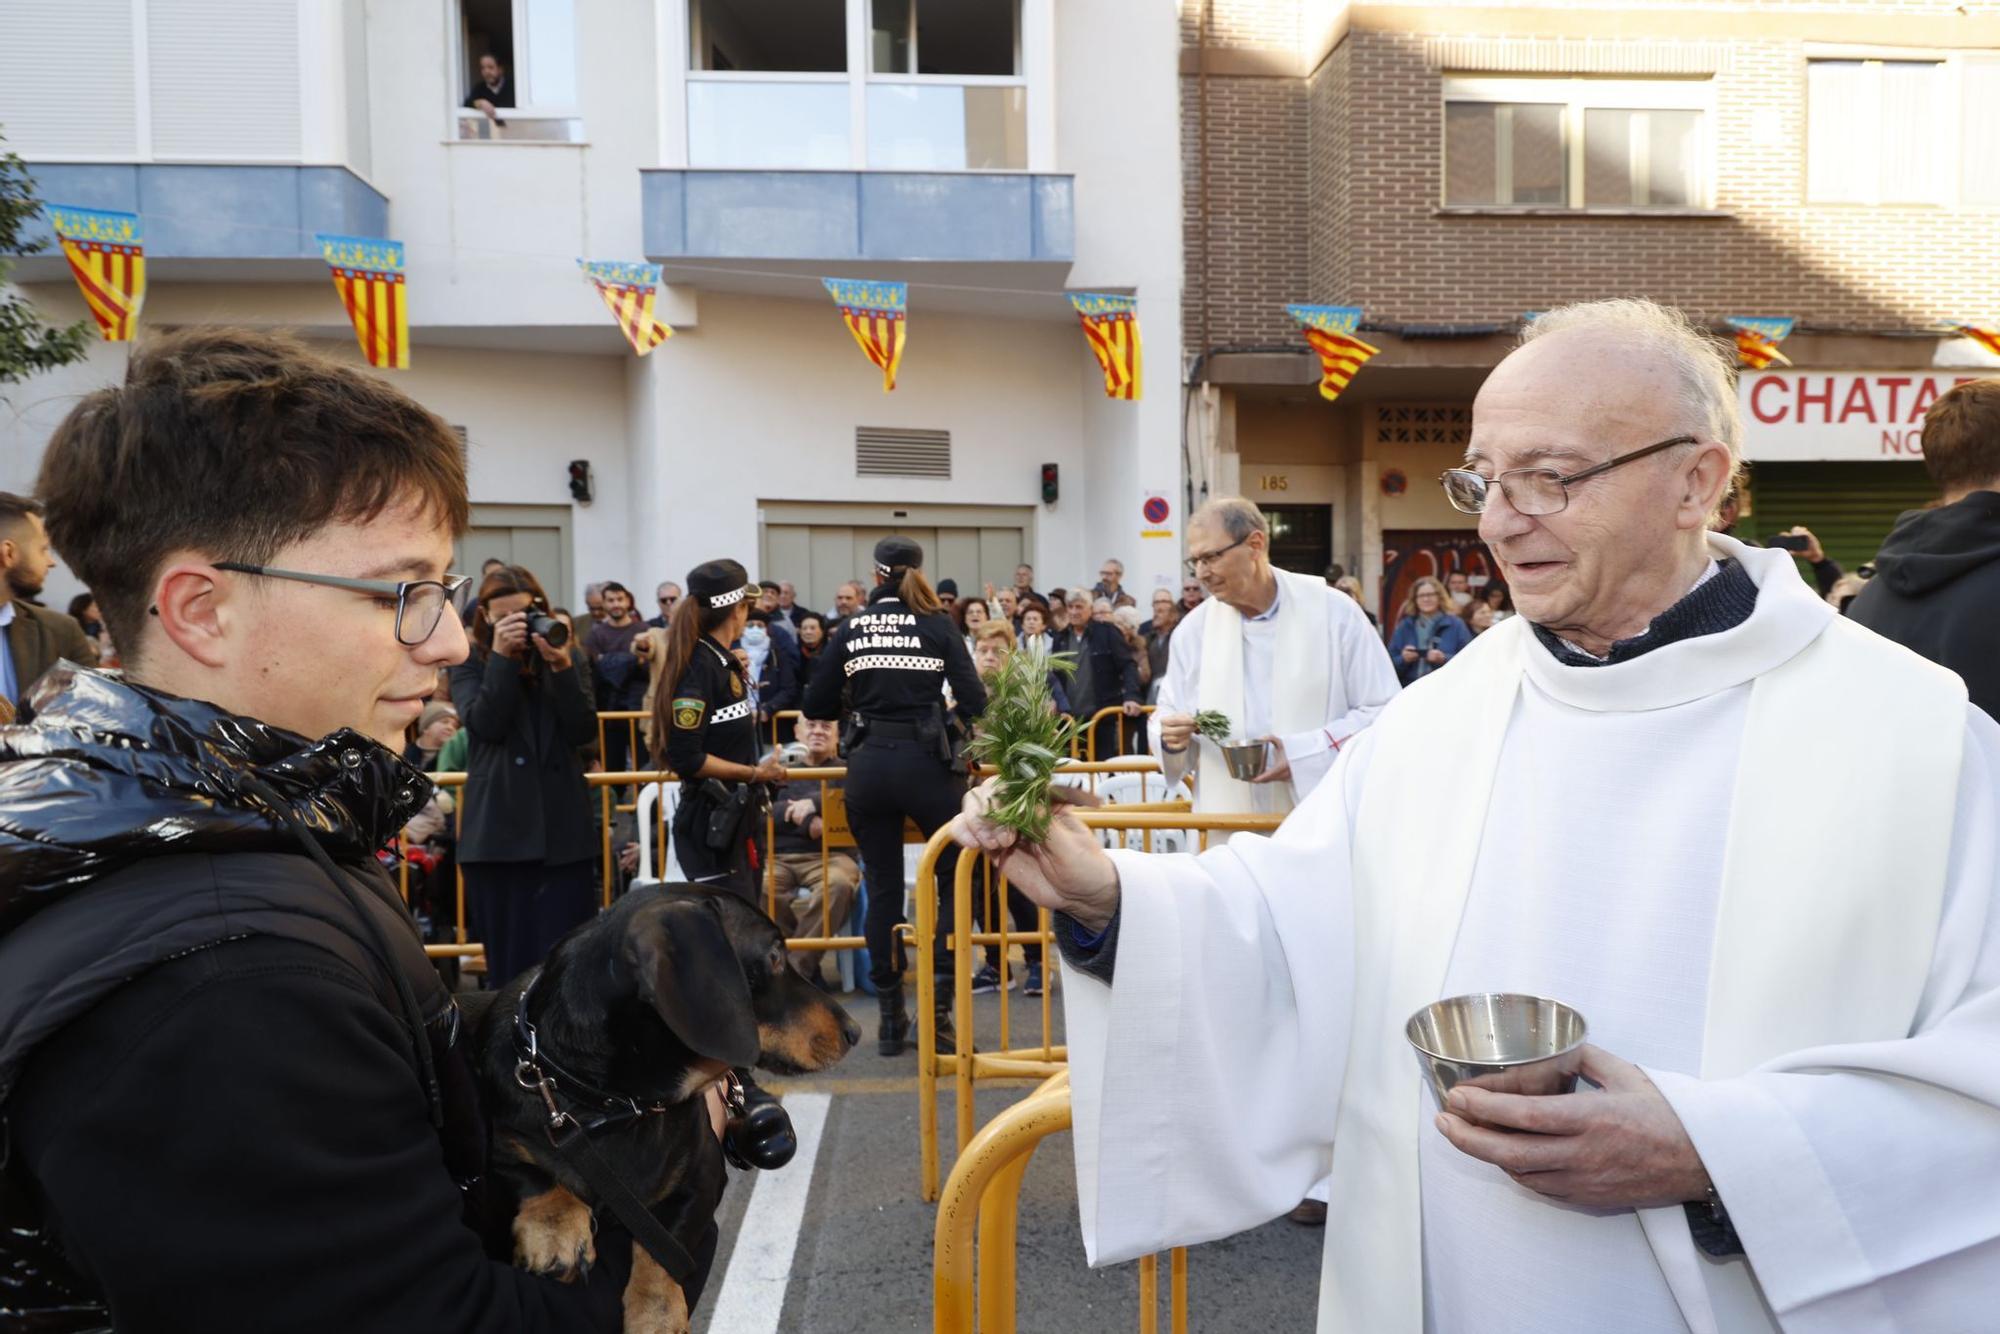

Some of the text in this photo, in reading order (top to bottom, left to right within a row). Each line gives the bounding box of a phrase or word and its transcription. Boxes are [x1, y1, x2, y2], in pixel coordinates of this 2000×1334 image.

[1750, 375, 1979, 424] CHATA
[1262, 475, 1288, 491] 185
[850, 614, 916, 629] POLICIA
[863, 625, 899, 633] LOCAL
[846, 634, 921, 653] VALÈNCIA
